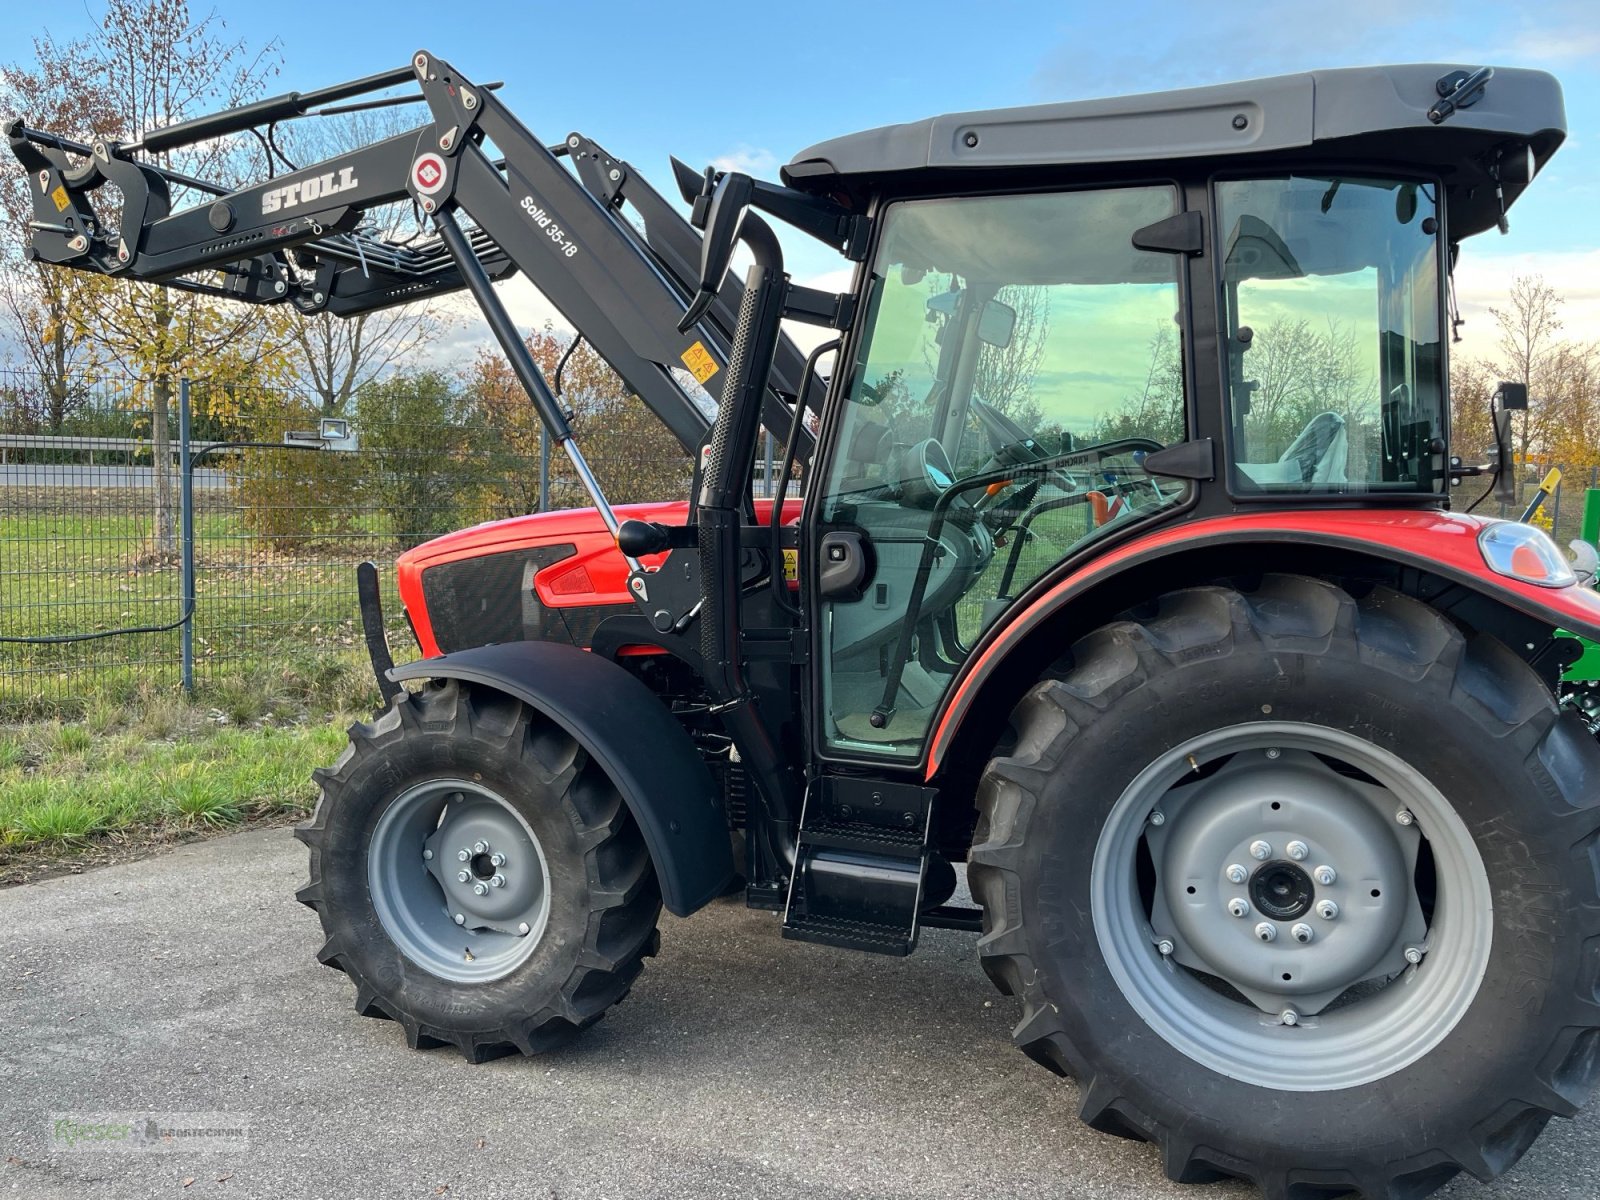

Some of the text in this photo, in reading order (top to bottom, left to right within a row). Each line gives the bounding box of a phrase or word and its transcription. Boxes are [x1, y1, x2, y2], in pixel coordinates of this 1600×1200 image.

[262, 166, 358, 215] STOLL
[520, 195, 578, 258] Solid 35-18
